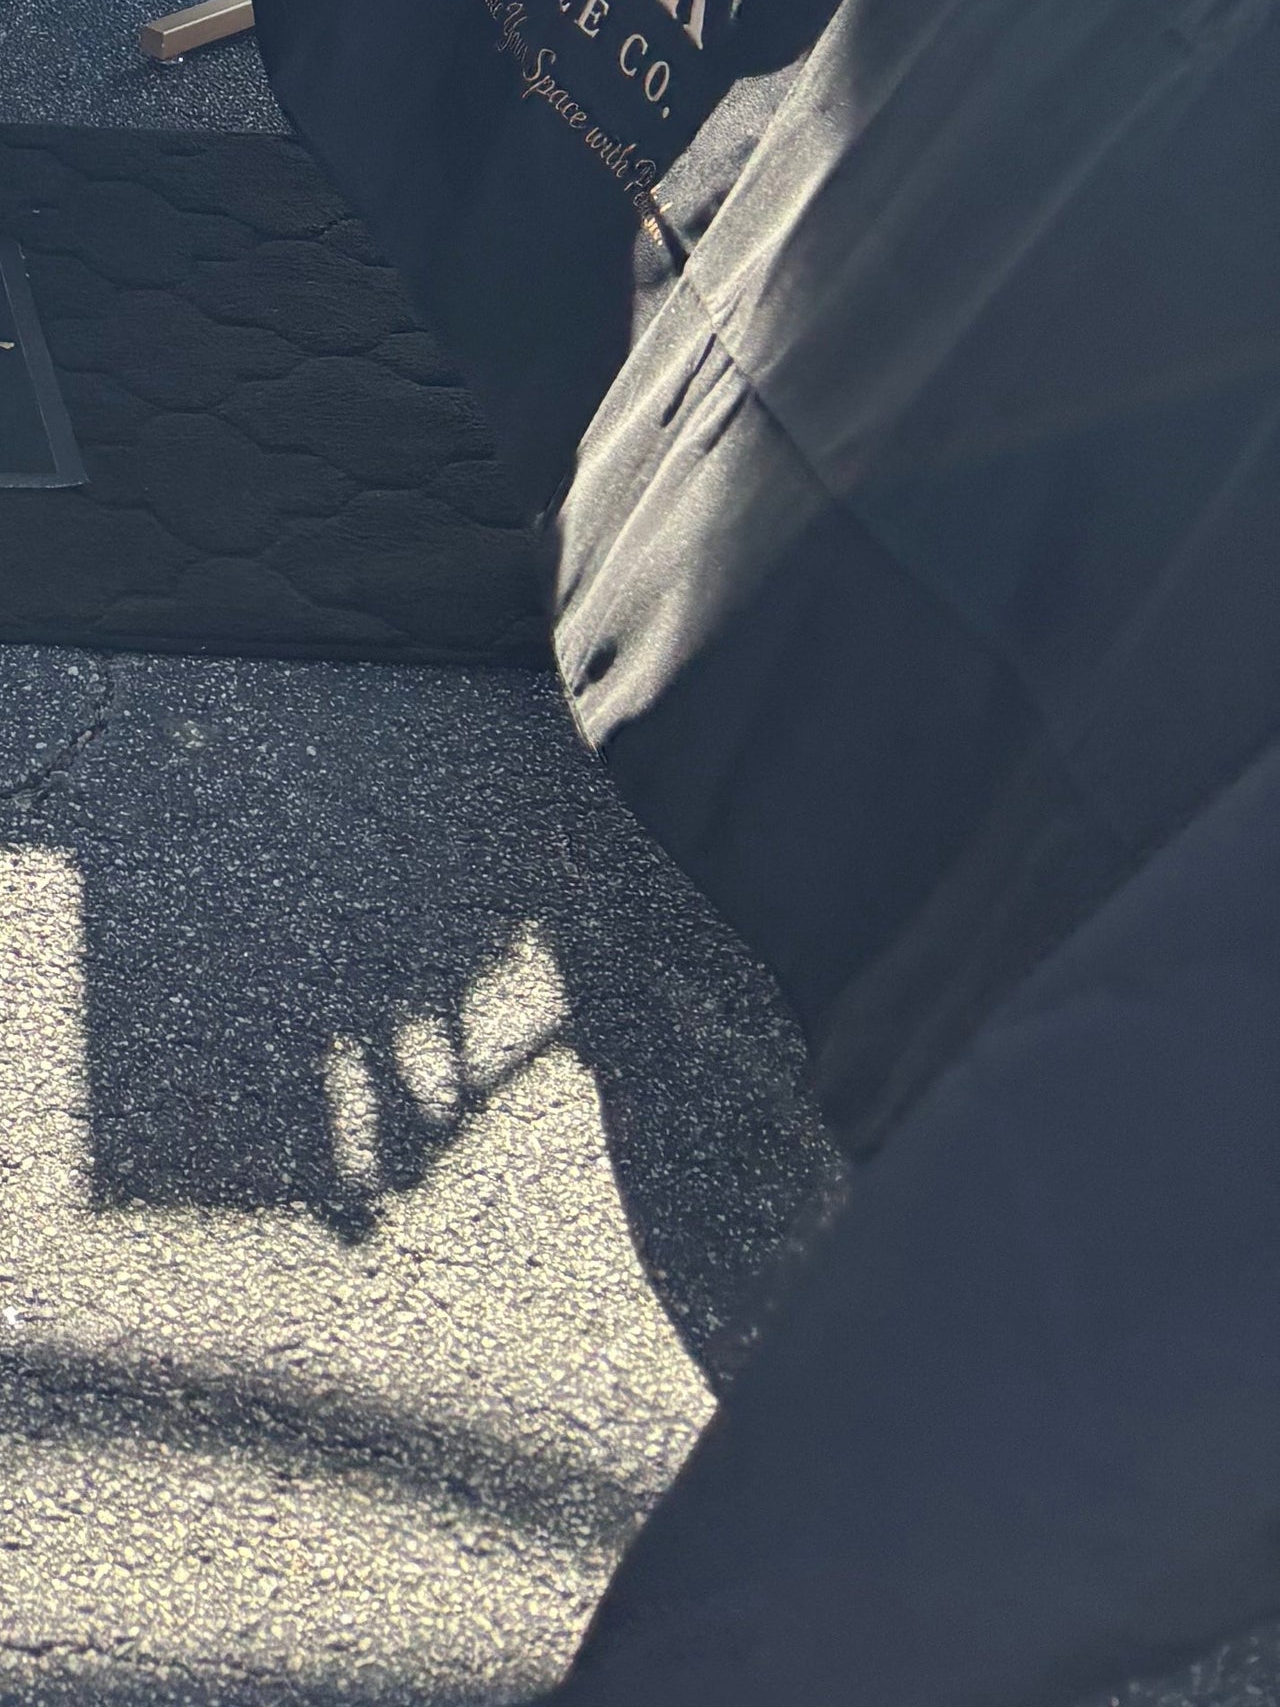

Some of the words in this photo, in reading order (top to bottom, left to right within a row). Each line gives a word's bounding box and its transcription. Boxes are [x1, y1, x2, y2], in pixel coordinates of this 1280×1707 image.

[521, 48, 587, 129] Space
[585, 126, 636, 178] with
[619, 33, 670, 120] CO.
